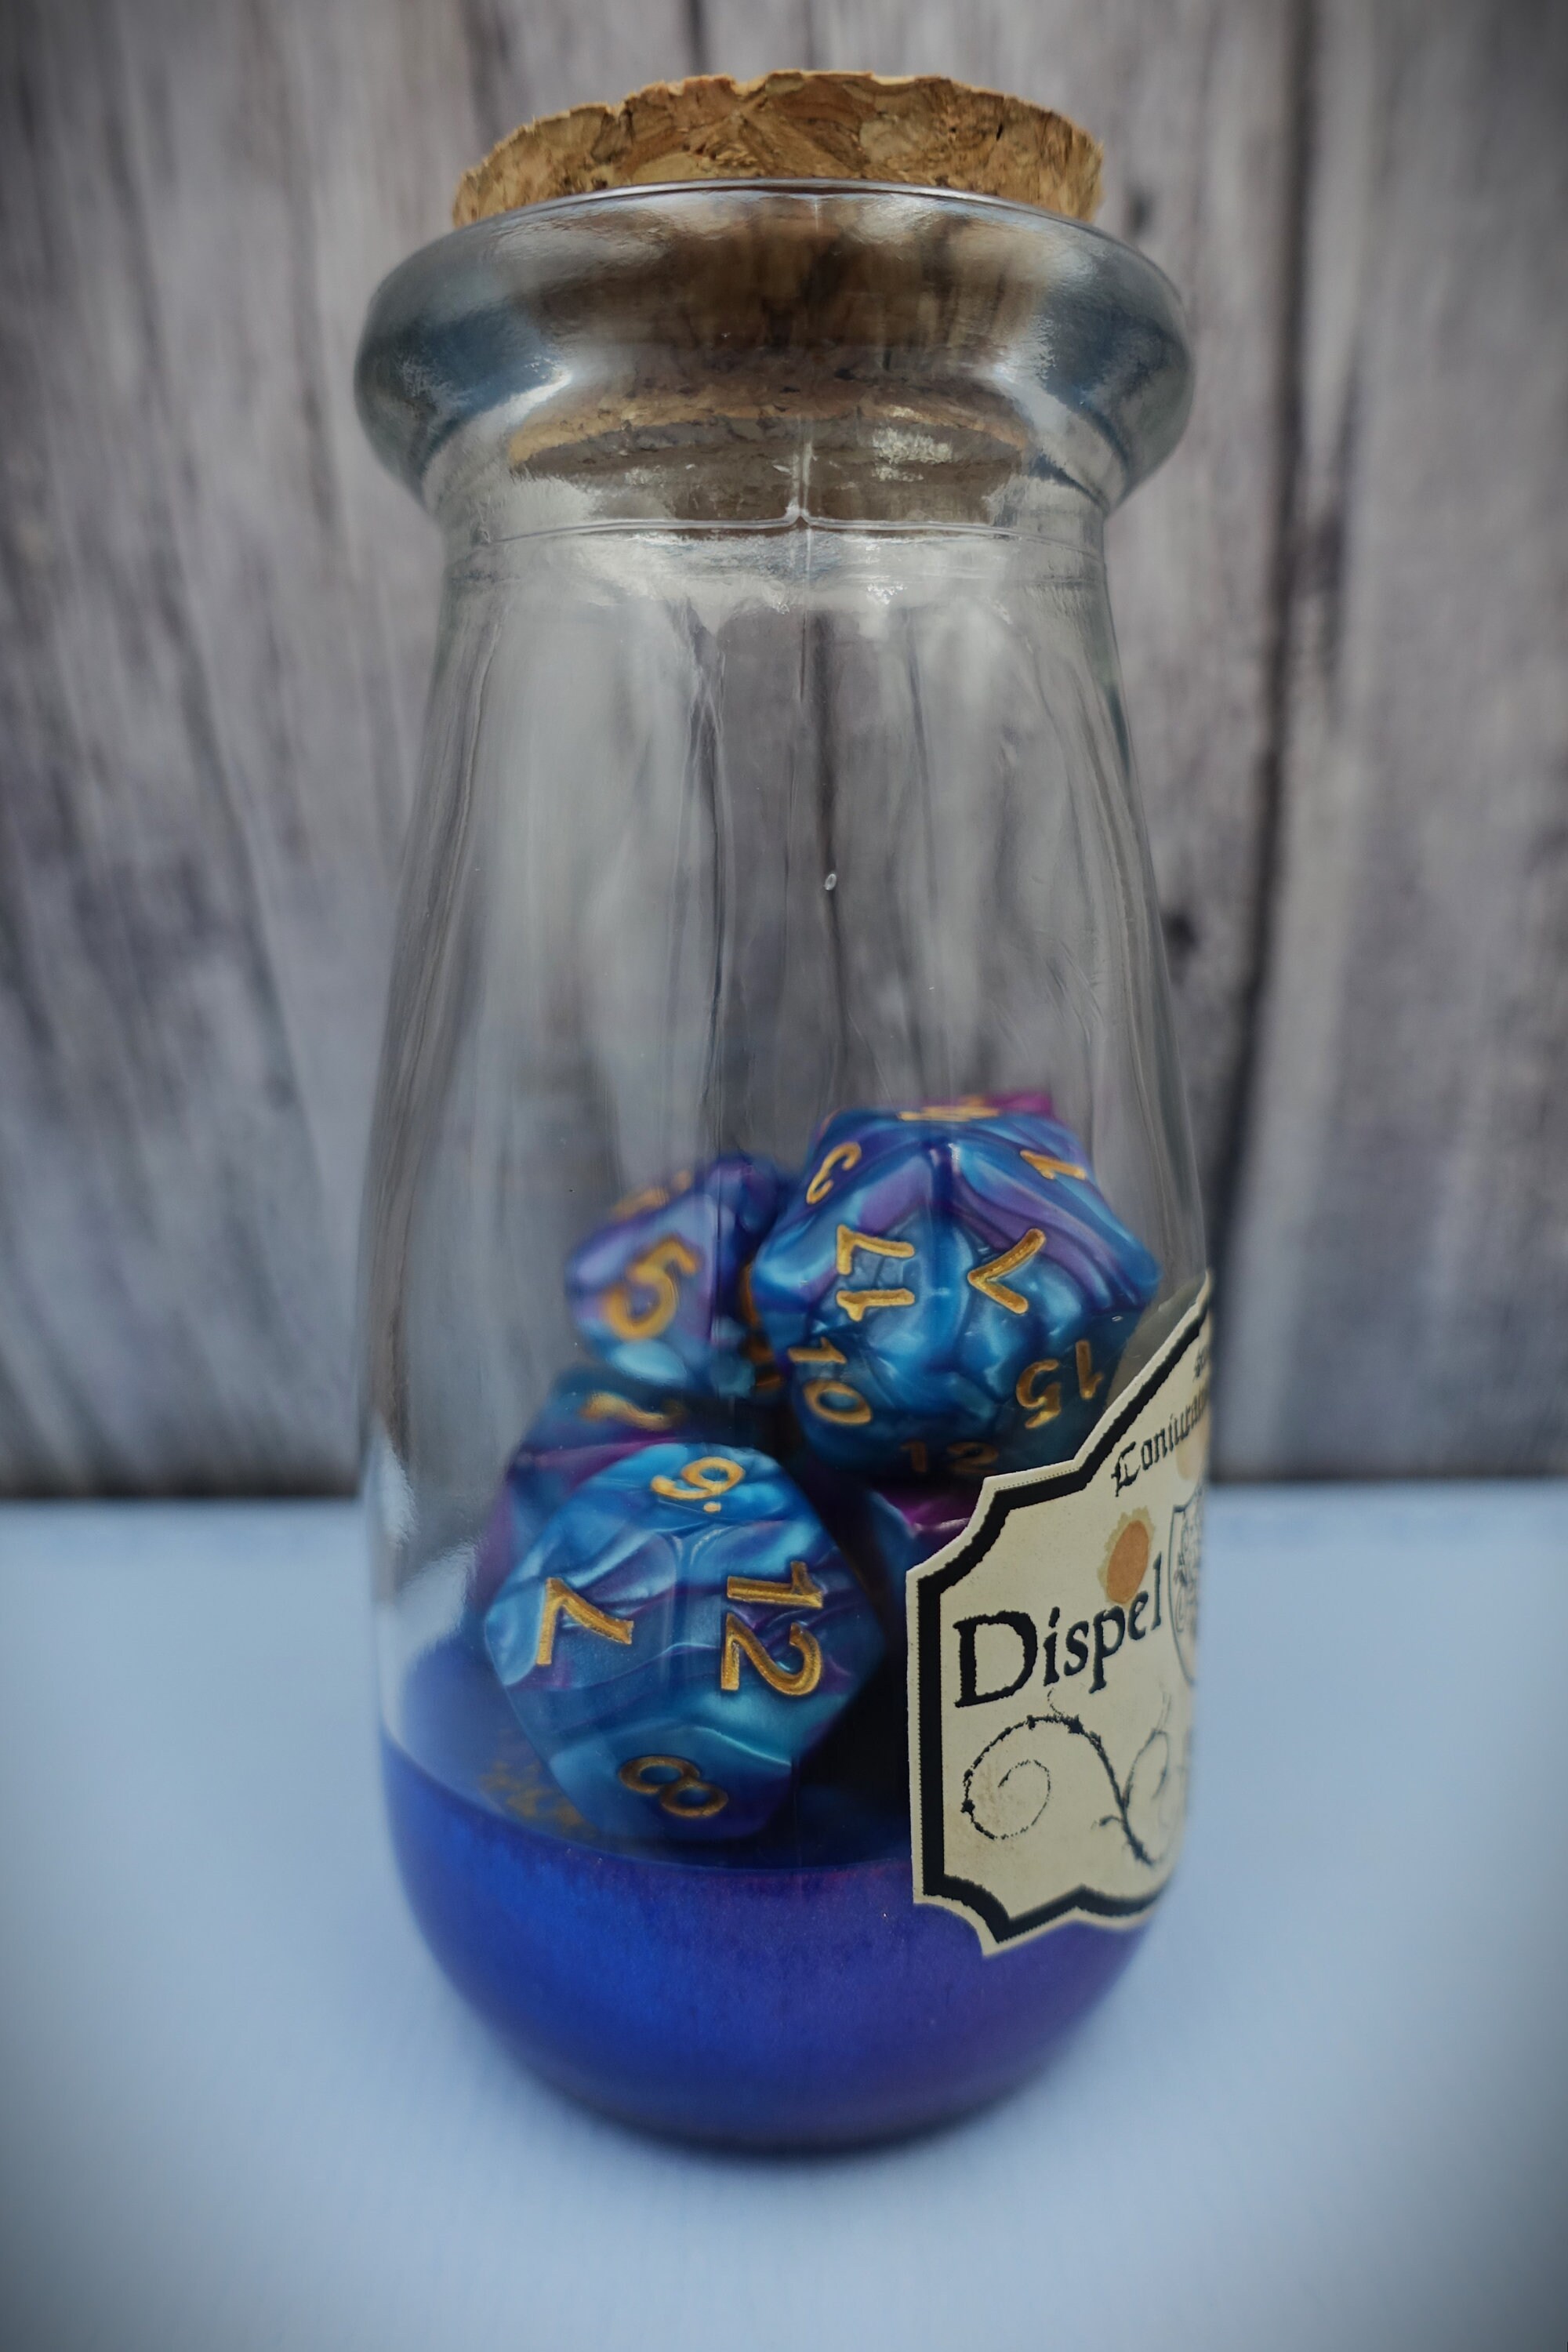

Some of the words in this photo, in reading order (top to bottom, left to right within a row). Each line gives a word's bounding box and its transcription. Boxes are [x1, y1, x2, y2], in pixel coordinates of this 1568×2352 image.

[535, 1577, 634, 1665] 7
[720, 1561, 823, 1697] 12
[953, 1552, 1162, 1708] Dispel
[618, 1755, 728, 1818] 8
